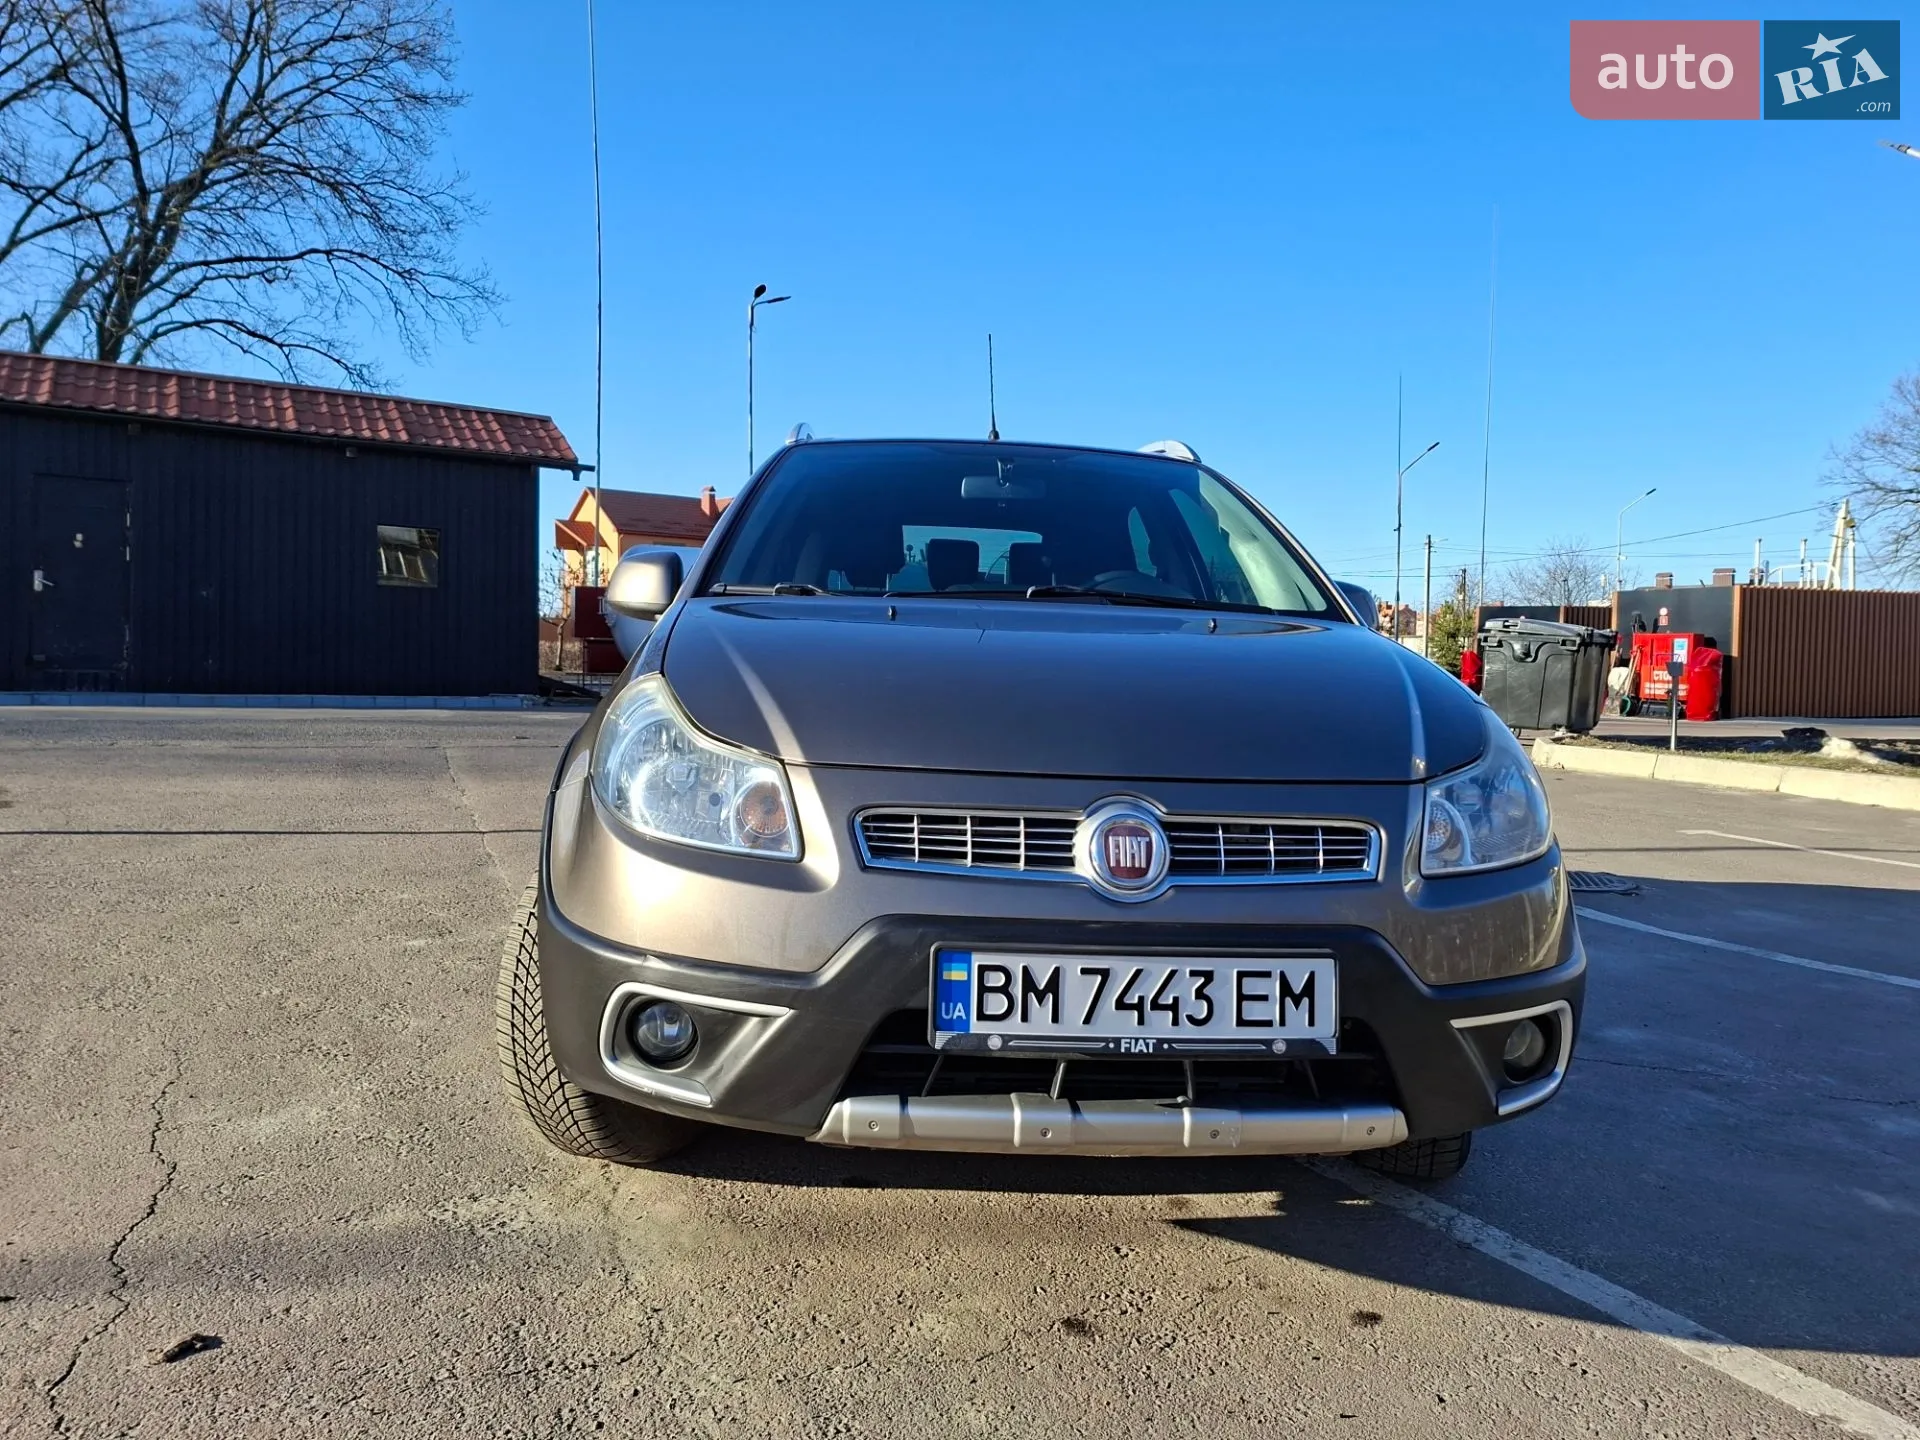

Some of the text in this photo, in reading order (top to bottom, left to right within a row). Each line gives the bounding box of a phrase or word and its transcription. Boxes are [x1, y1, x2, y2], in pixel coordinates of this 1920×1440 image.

[1109, 835, 1149, 868] FIAT
[975, 964, 1315, 1028] BM 7443 EM
[941, 1002, 967, 1020] UA
[1120, 1039, 1156, 1054] FIAT
